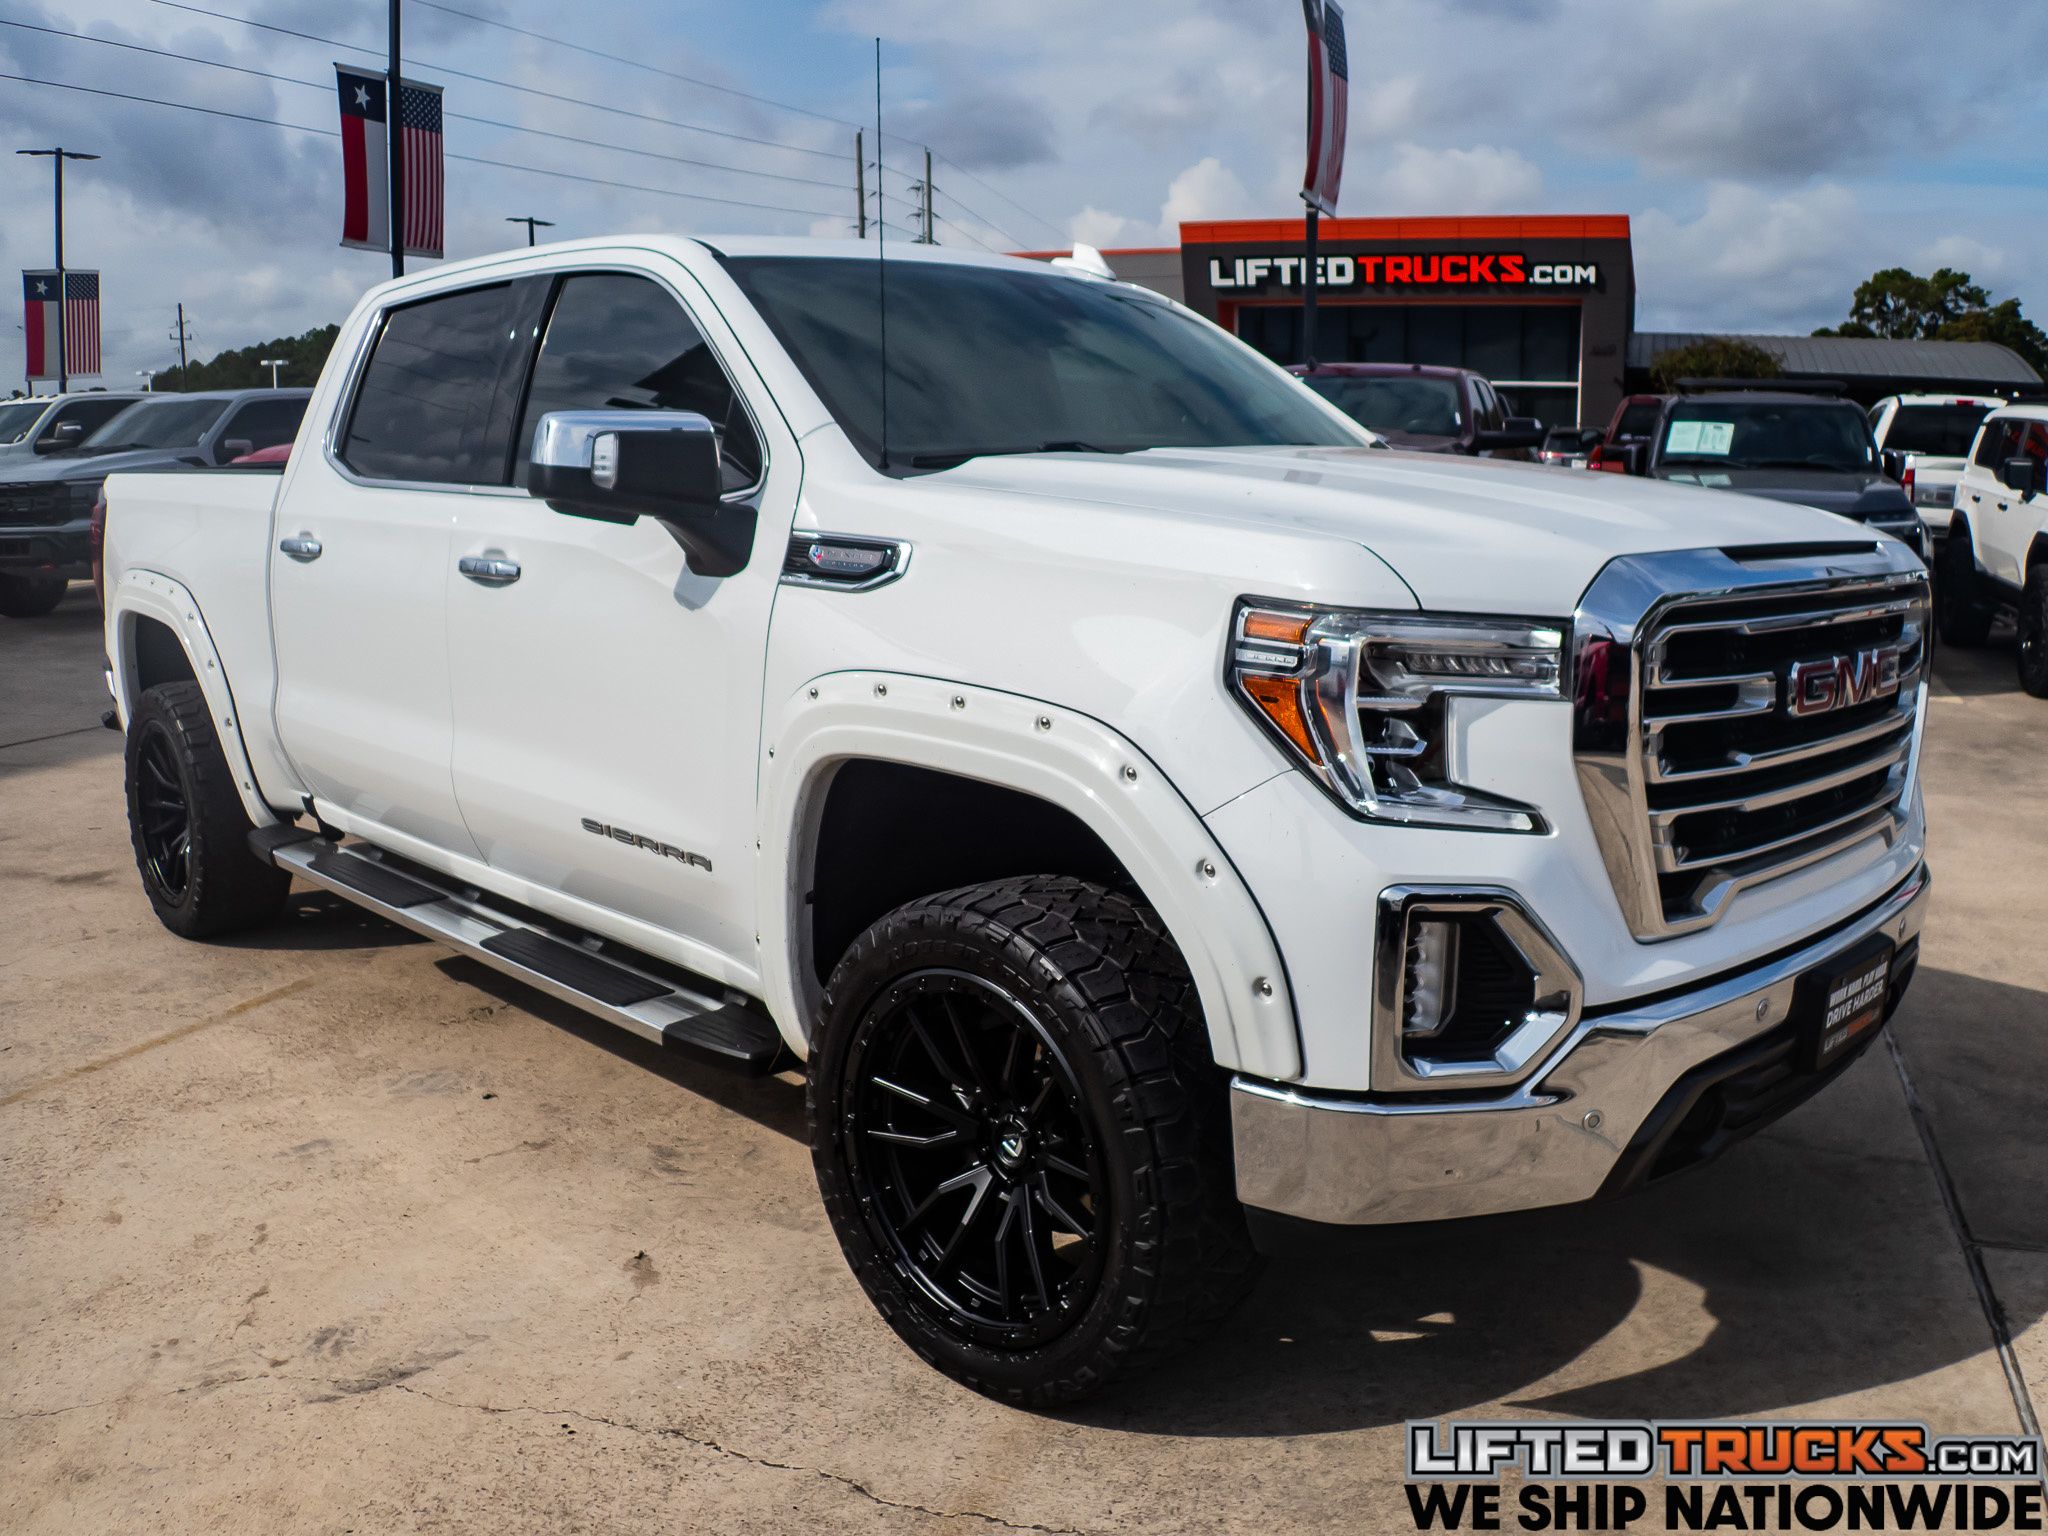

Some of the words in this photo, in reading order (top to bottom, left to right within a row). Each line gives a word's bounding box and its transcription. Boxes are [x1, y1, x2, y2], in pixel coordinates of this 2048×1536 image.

[1790, 645, 1900, 715] GMC
[580, 817, 713, 873] SIERRA
[1825, 1000, 1853, 1029] DRIVE
